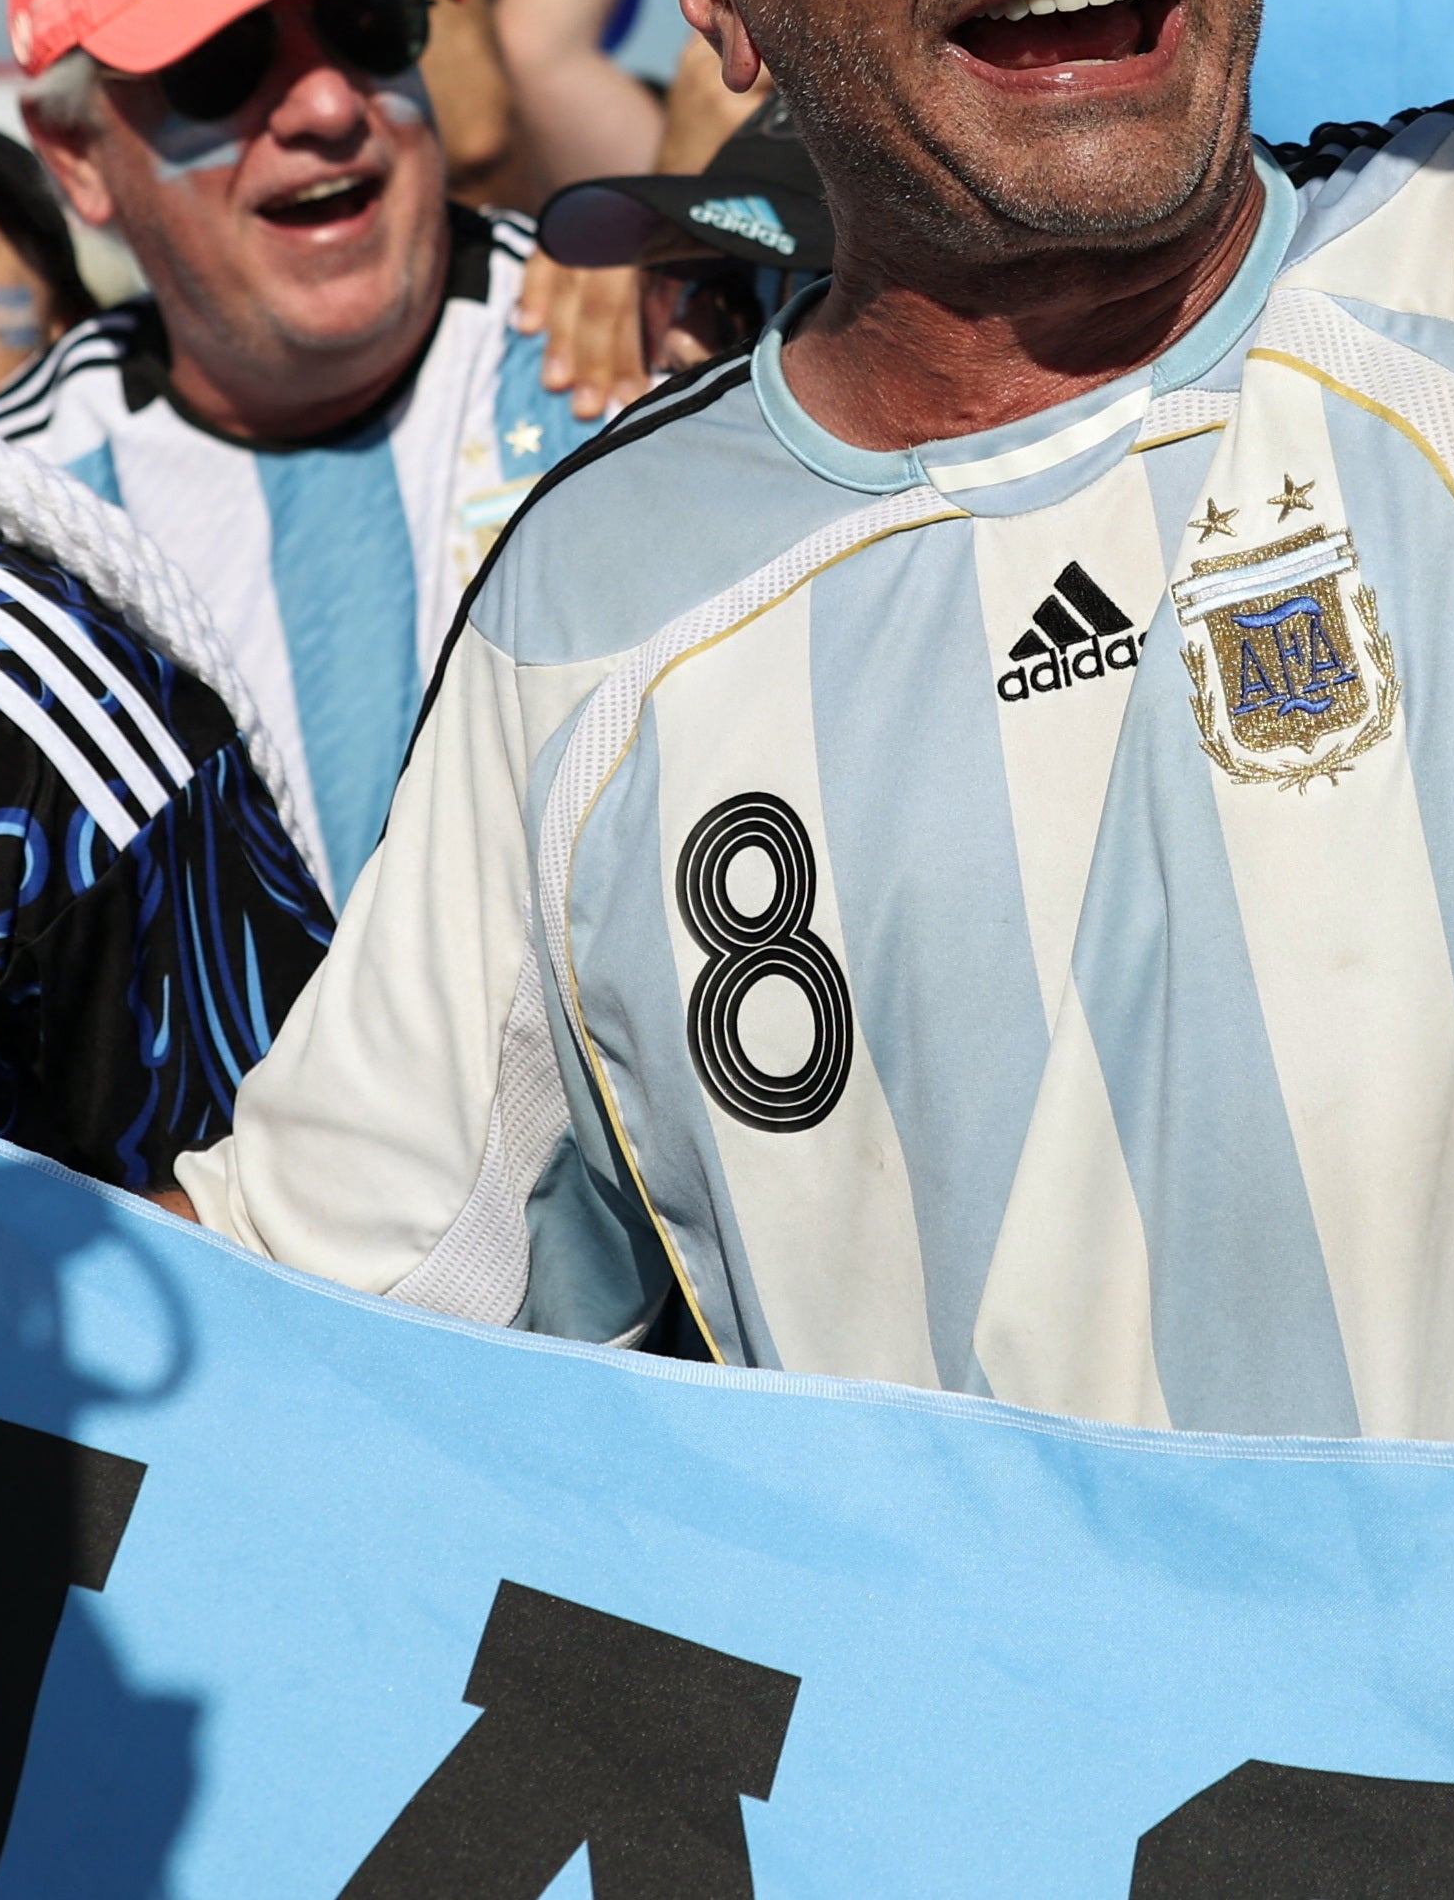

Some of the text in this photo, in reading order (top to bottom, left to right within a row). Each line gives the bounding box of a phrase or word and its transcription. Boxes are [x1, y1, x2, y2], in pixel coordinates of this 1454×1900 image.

[689, 204, 796, 256] adidas
[997, 630, 1148, 702] adida
[675, 791, 854, 1134] 8
